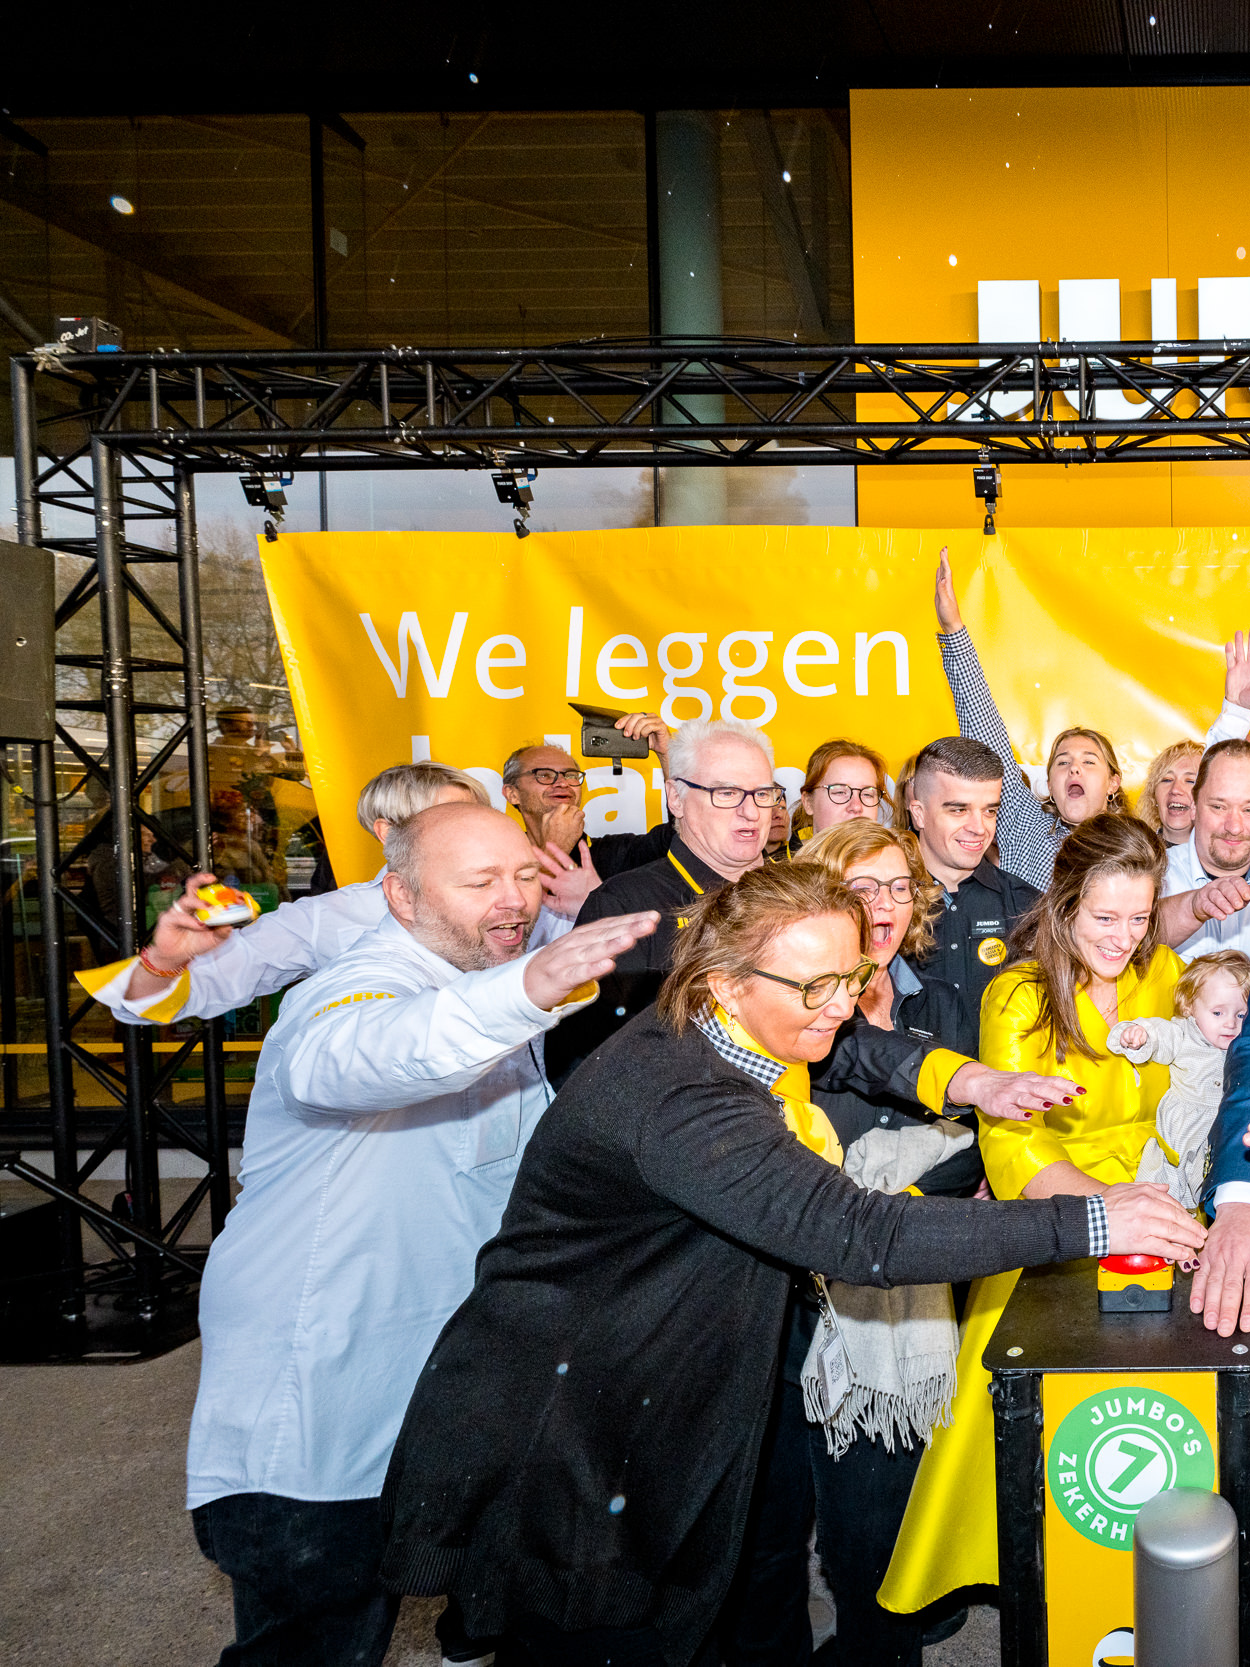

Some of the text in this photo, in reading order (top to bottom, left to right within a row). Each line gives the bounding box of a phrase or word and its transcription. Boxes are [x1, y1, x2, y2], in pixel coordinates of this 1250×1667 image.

[359, 606, 911, 728] We leggen
[1090, 1397, 1202, 1456] JUMBO'S
[1058, 1451, 1135, 1542] ZEKERH
[1107, 1439, 1159, 1494] 7
